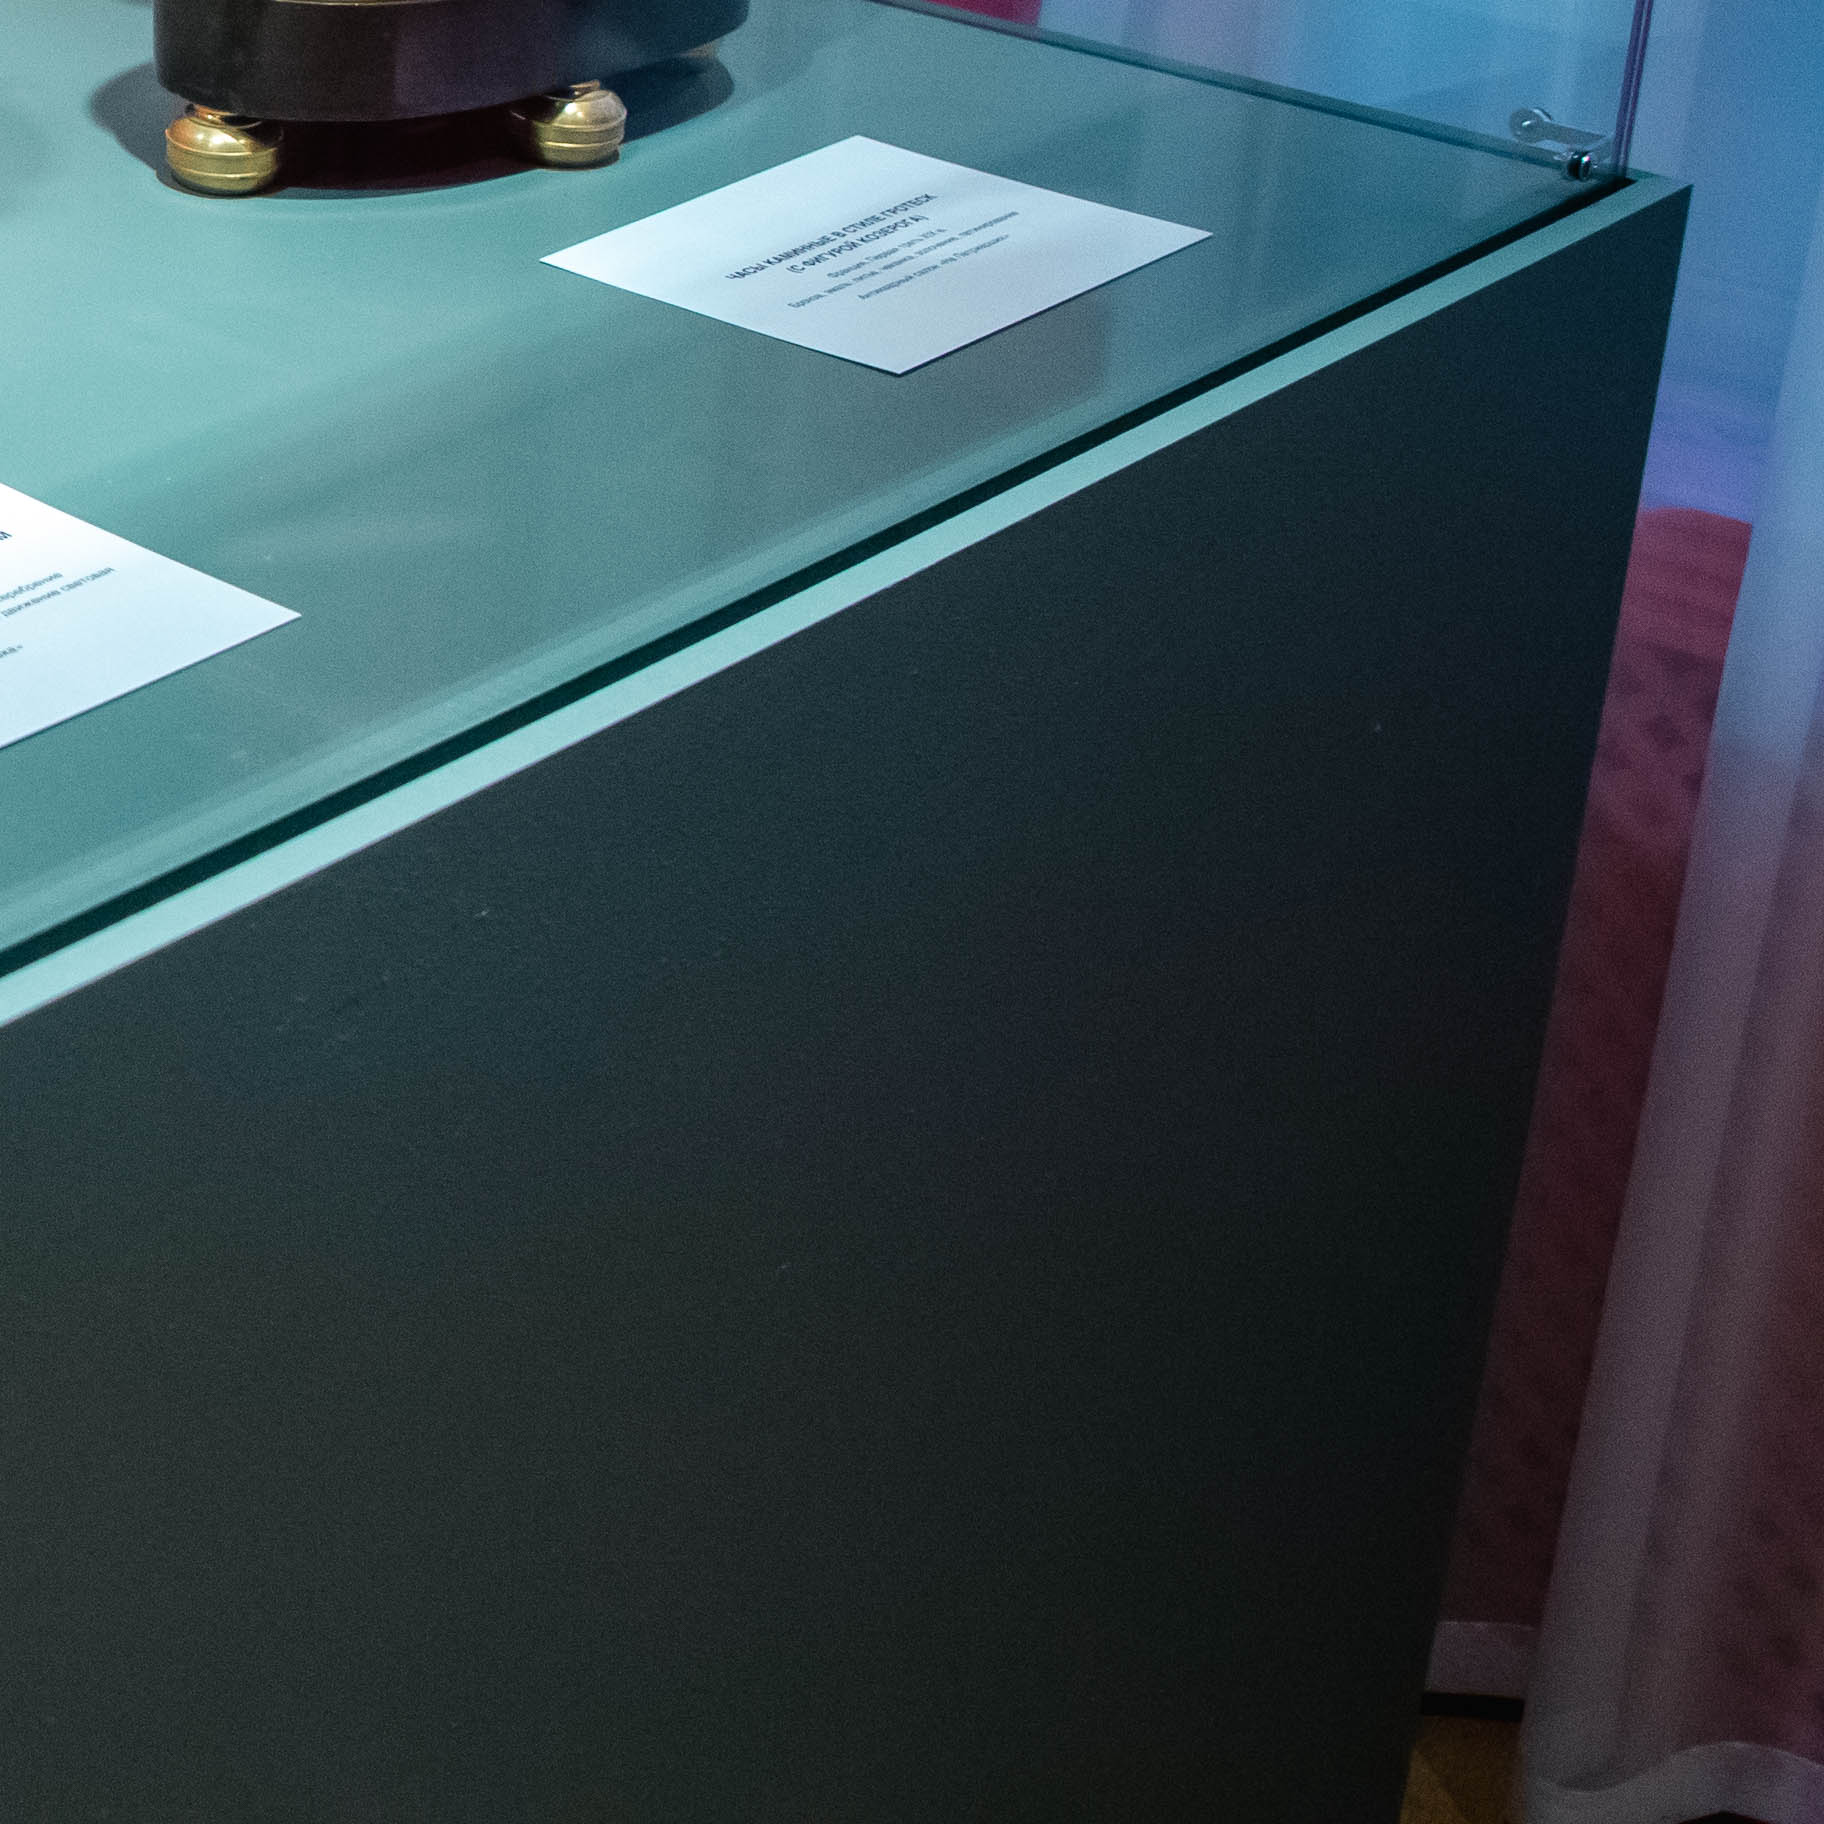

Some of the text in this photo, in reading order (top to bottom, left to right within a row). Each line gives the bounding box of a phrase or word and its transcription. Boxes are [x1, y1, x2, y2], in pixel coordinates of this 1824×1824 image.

[725, 263, 768, 279] ЧАСЫ
[762, 235, 836, 265] КАМИННЫЕ
[841, 214, 886, 233] СТИЛЕ
[879, 193, 937, 217] ГРОТЕСК
[801, 240, 861, 266] ФИГУРОЙ
